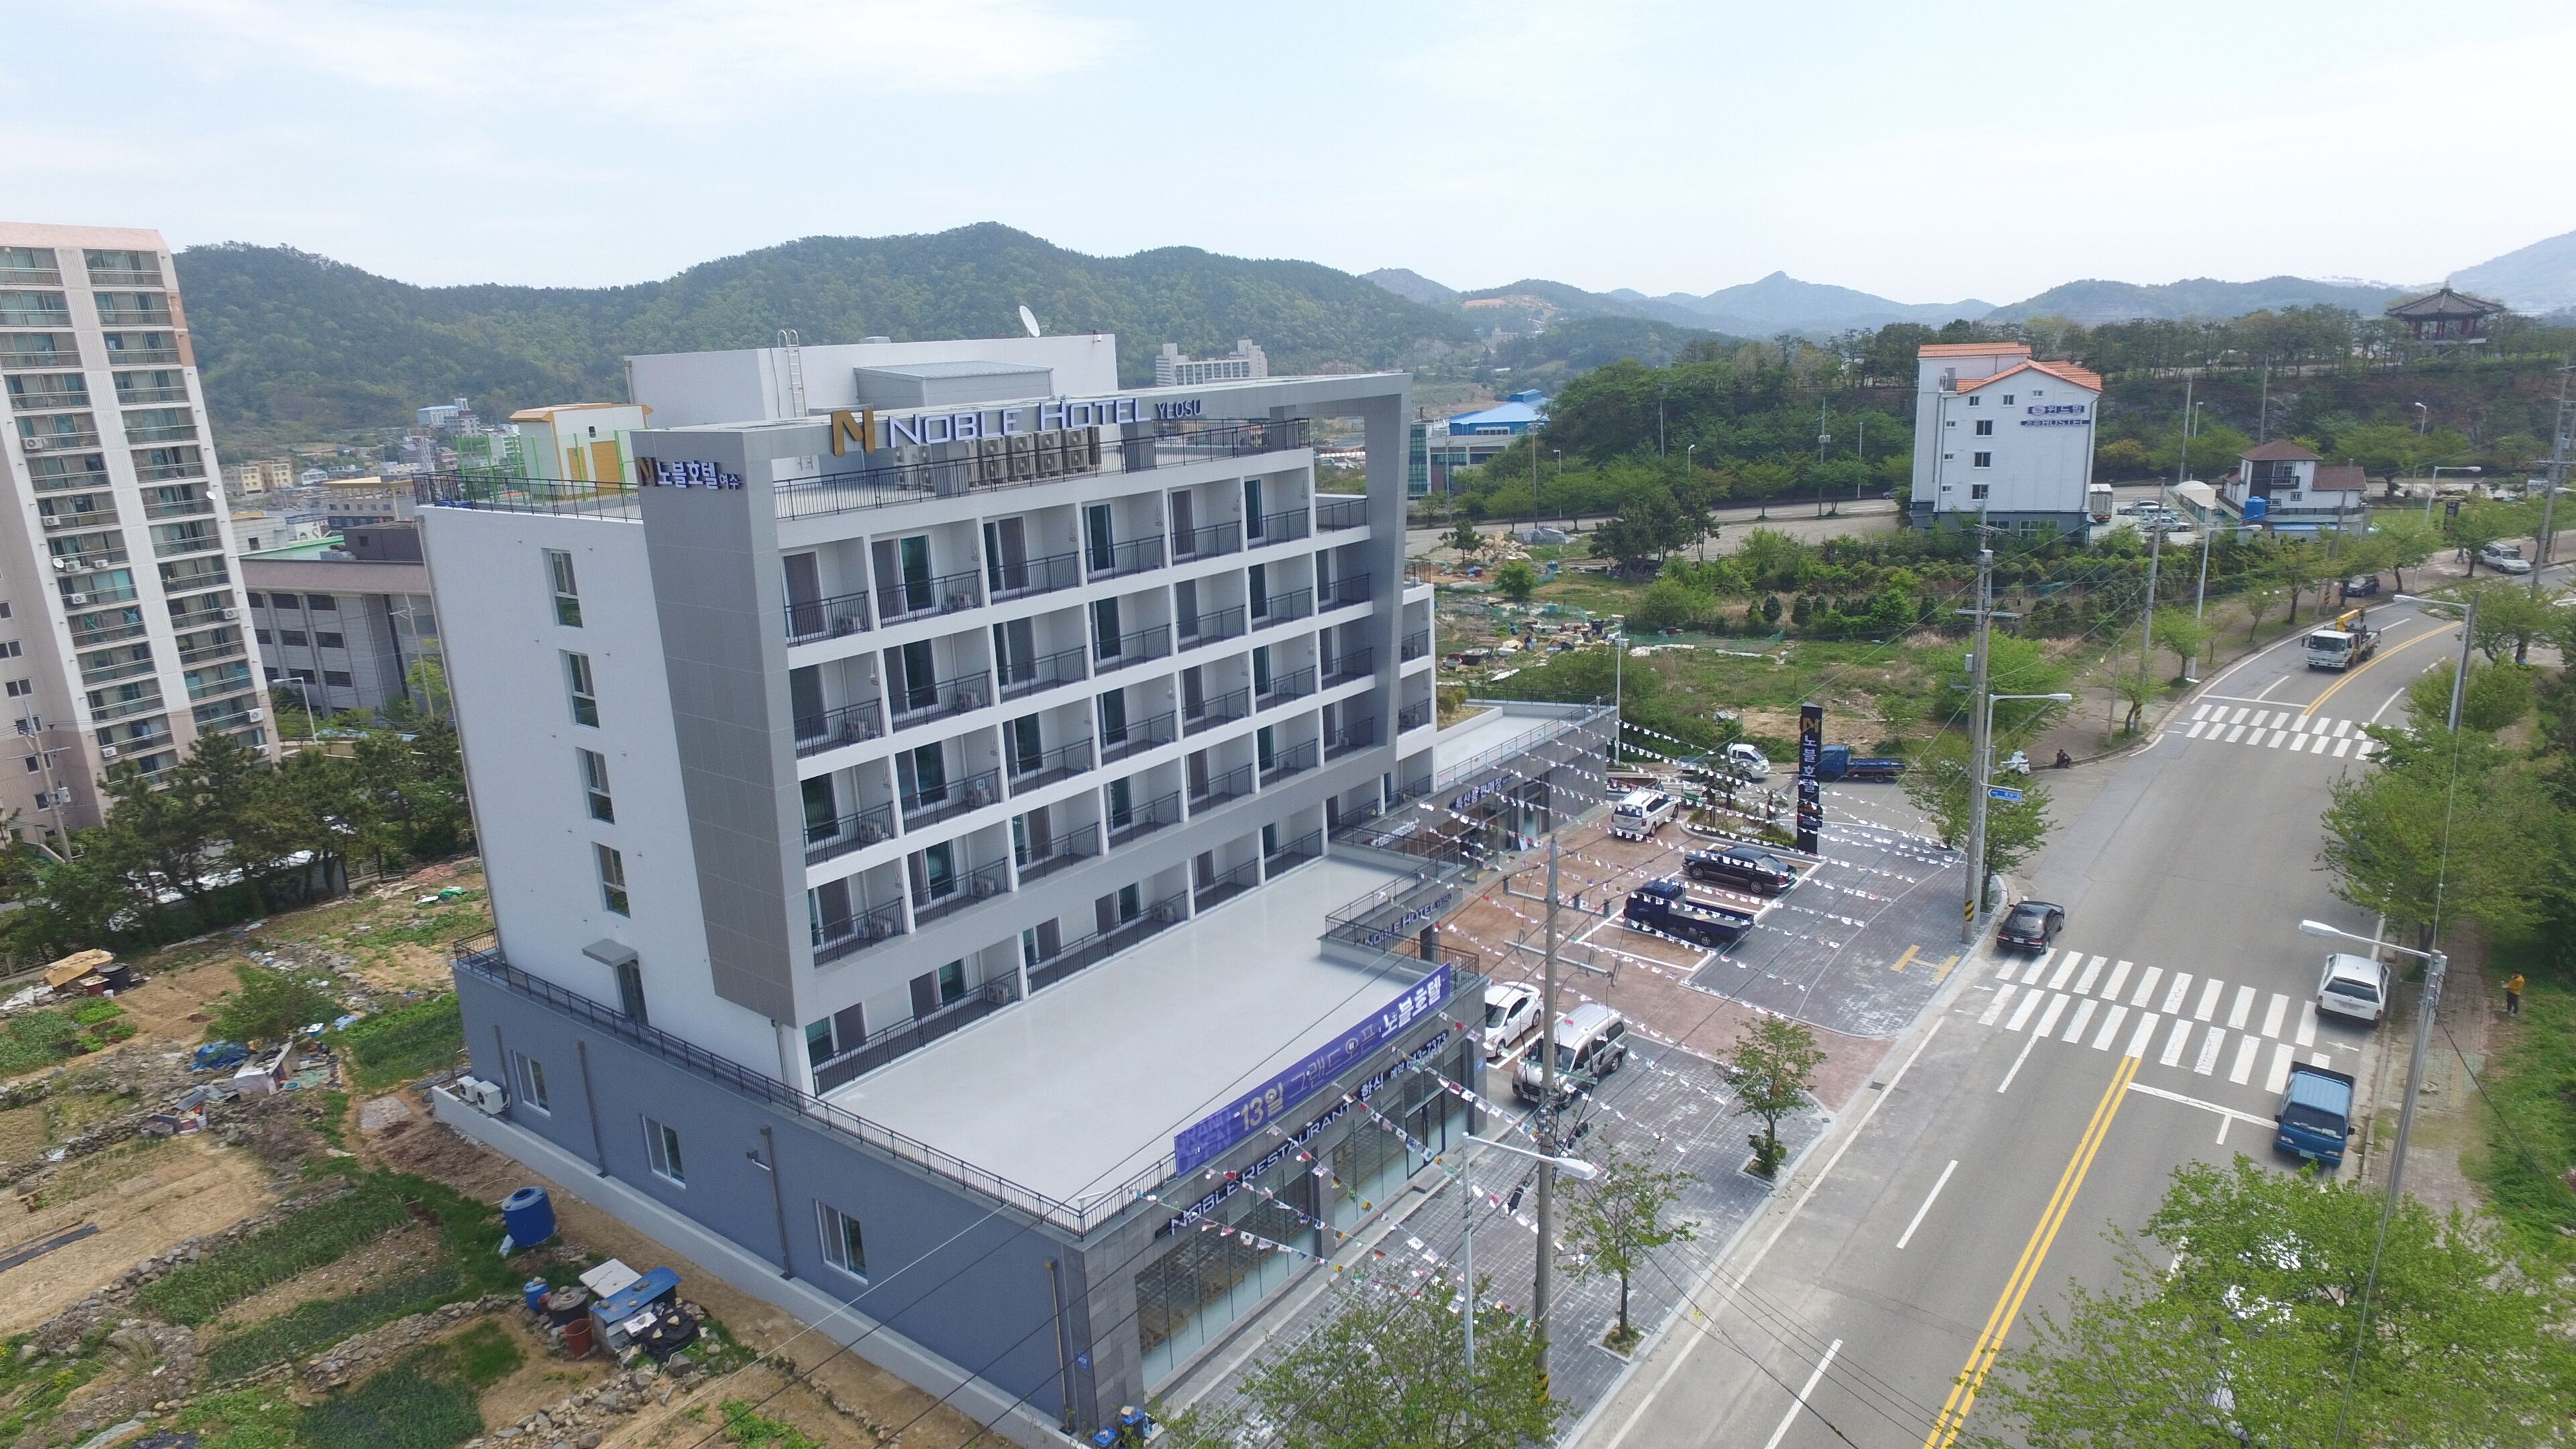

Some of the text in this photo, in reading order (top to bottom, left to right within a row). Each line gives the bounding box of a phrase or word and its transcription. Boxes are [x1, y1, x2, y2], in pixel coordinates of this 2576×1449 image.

[888, 407, 1024, 448] NOBLE
[1038, 398, 1151, 433] HOTEL
[1155, 399, 1203, 420] YEOSU
[657, 460, 718, 490] 노블호텔
[719, 473, 740, 490] 여수
[1803, 735, 1817, 794] 노블호텔
[1401, 903, 1436, 928] HOTEL
[1241, 1082, 1284, 1132] 13일
[1381, 974, 1442, 1038] 노블호텔
[1171, 1182, 1238, 1236] NOBLE
[1242, 1100, 1350, 1183] RESTAURANT
[1360, 1072, 1384, 1103] 한식
